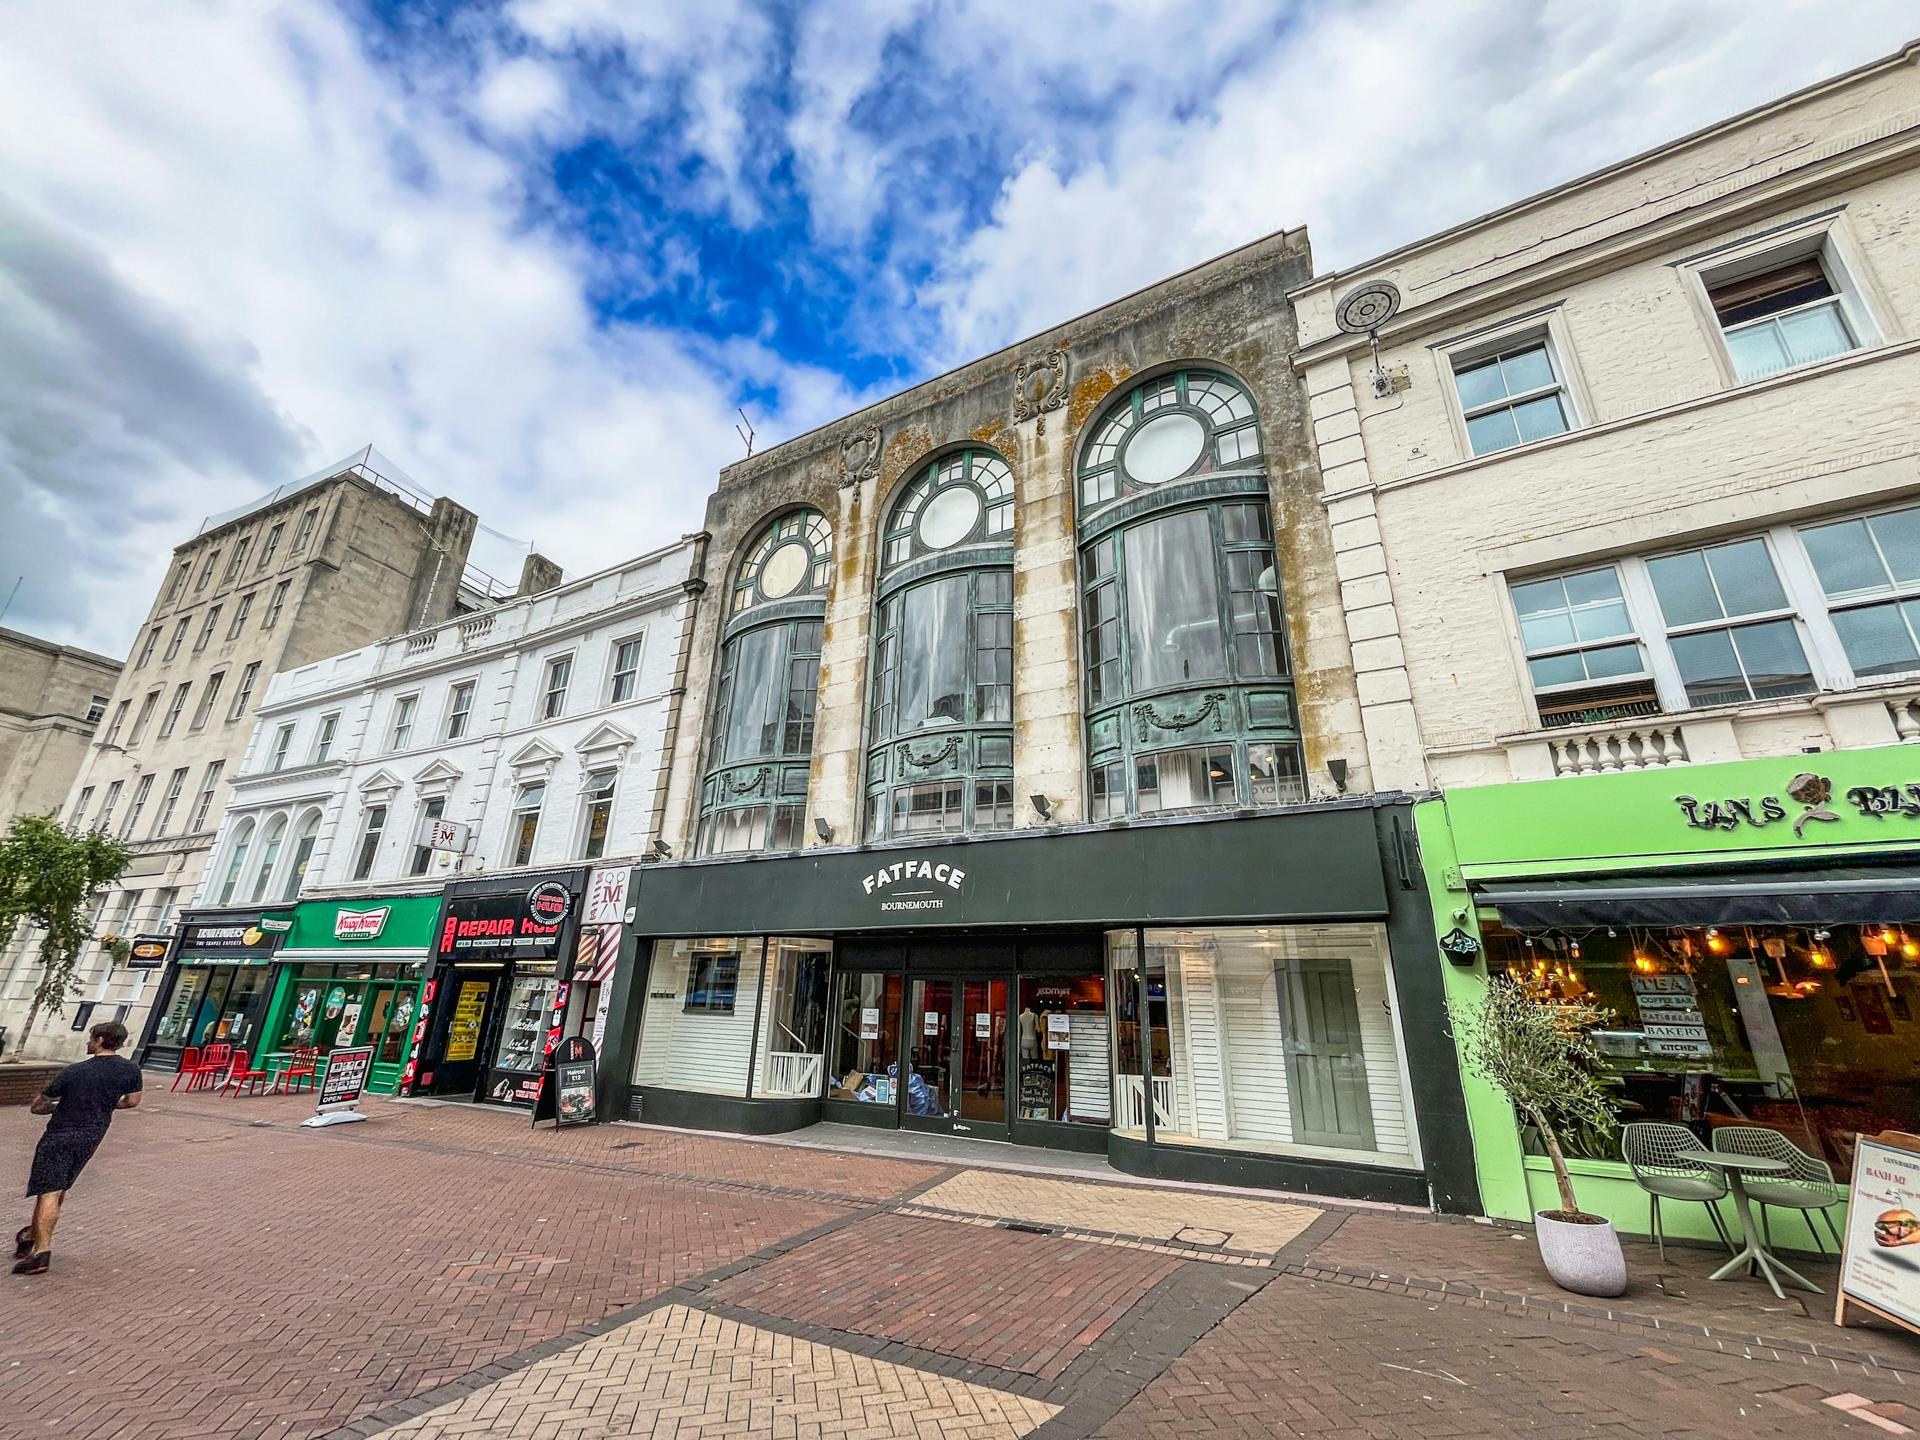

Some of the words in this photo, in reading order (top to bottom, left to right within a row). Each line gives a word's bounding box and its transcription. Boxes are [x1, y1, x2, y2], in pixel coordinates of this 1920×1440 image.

[862, 860, 965, 895] FATFACE
[536, 900, 563, 913] HUB
[881, 900, 944, 911] BOURNEMOUTH
[337, 915, 360, 931] Krispy
[358, 914, 382, 930] Kreme
[458, 918, 516, 937] REPAIR
[1638, 977, 1685, 992] TEA
[1647, 1026, 1702, 1037] BAKERY
[1659, 1044, 1699, 1052] KITCHEN
[322, 1095, 342, 1103] OPEN
[1865, 1167, 1892, 1182] BANH
